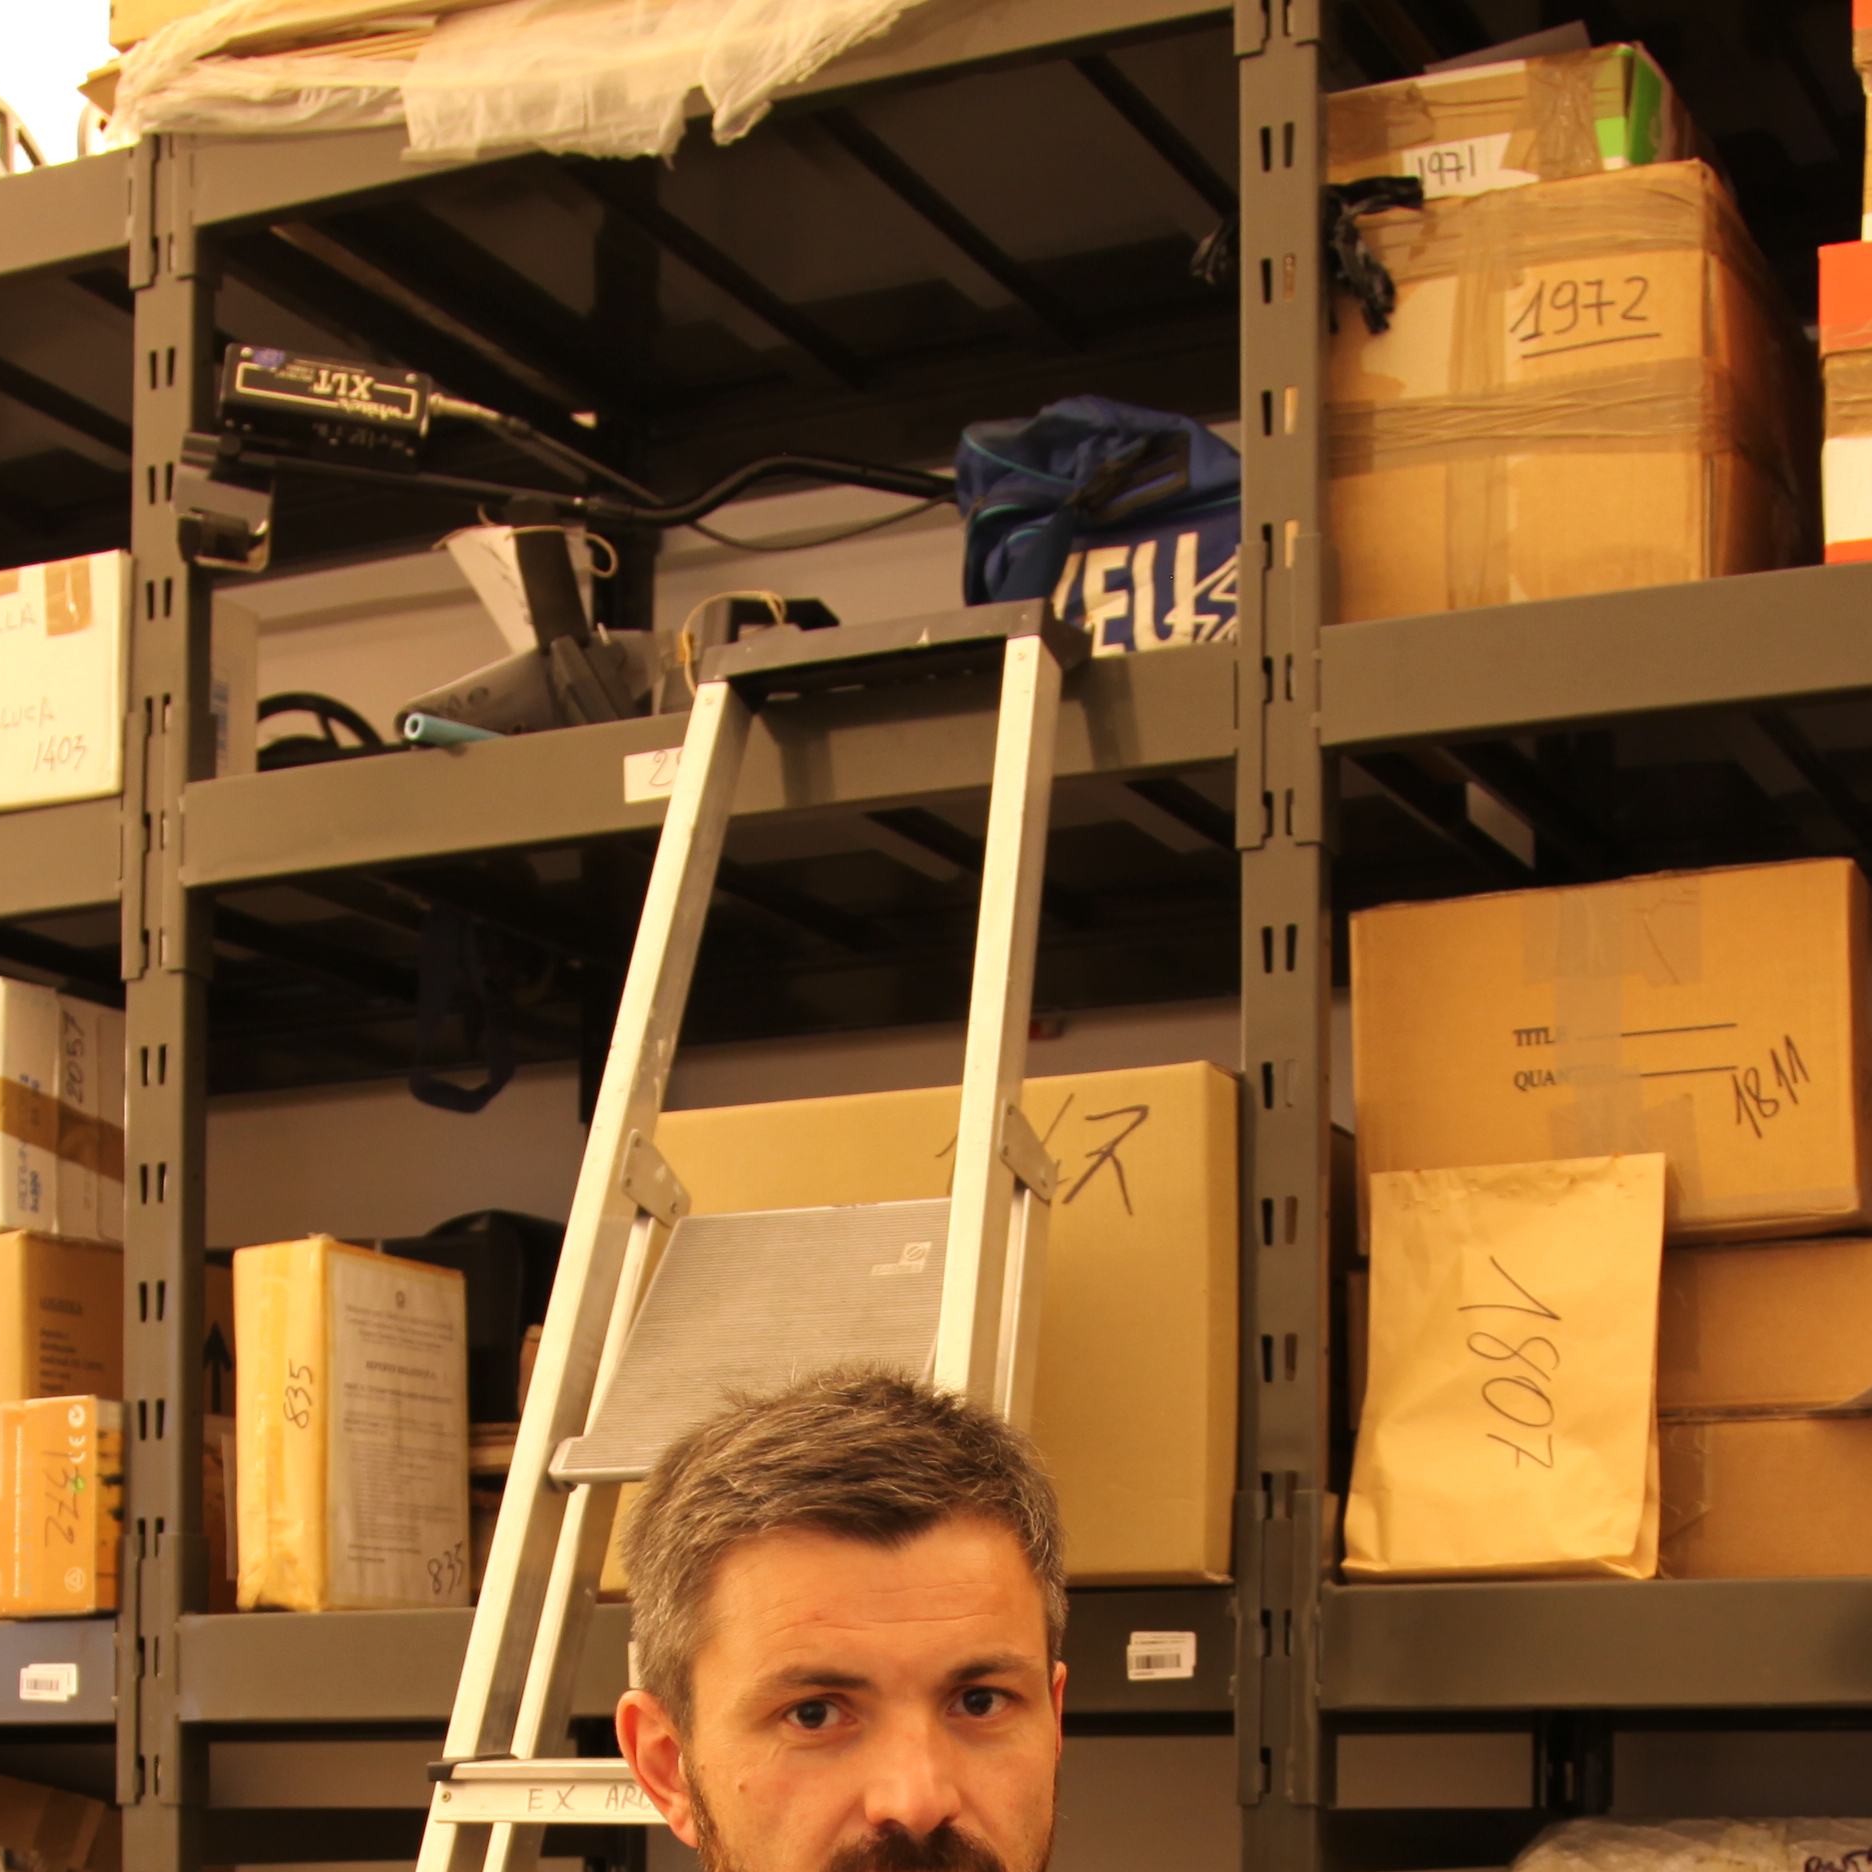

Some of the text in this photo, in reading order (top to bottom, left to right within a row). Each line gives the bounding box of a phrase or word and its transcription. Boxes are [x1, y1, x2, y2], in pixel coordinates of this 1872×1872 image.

[1417, 144, 1479, 185] 1971
[1511, 275, 1650, 339] 1972
[1458, 1256, 1563, 1470] 1807
[284, 1359, 313, 1429] 835
[428, 1541, 465, 1595] 835
[528, 1785, 576, 1813] EX
